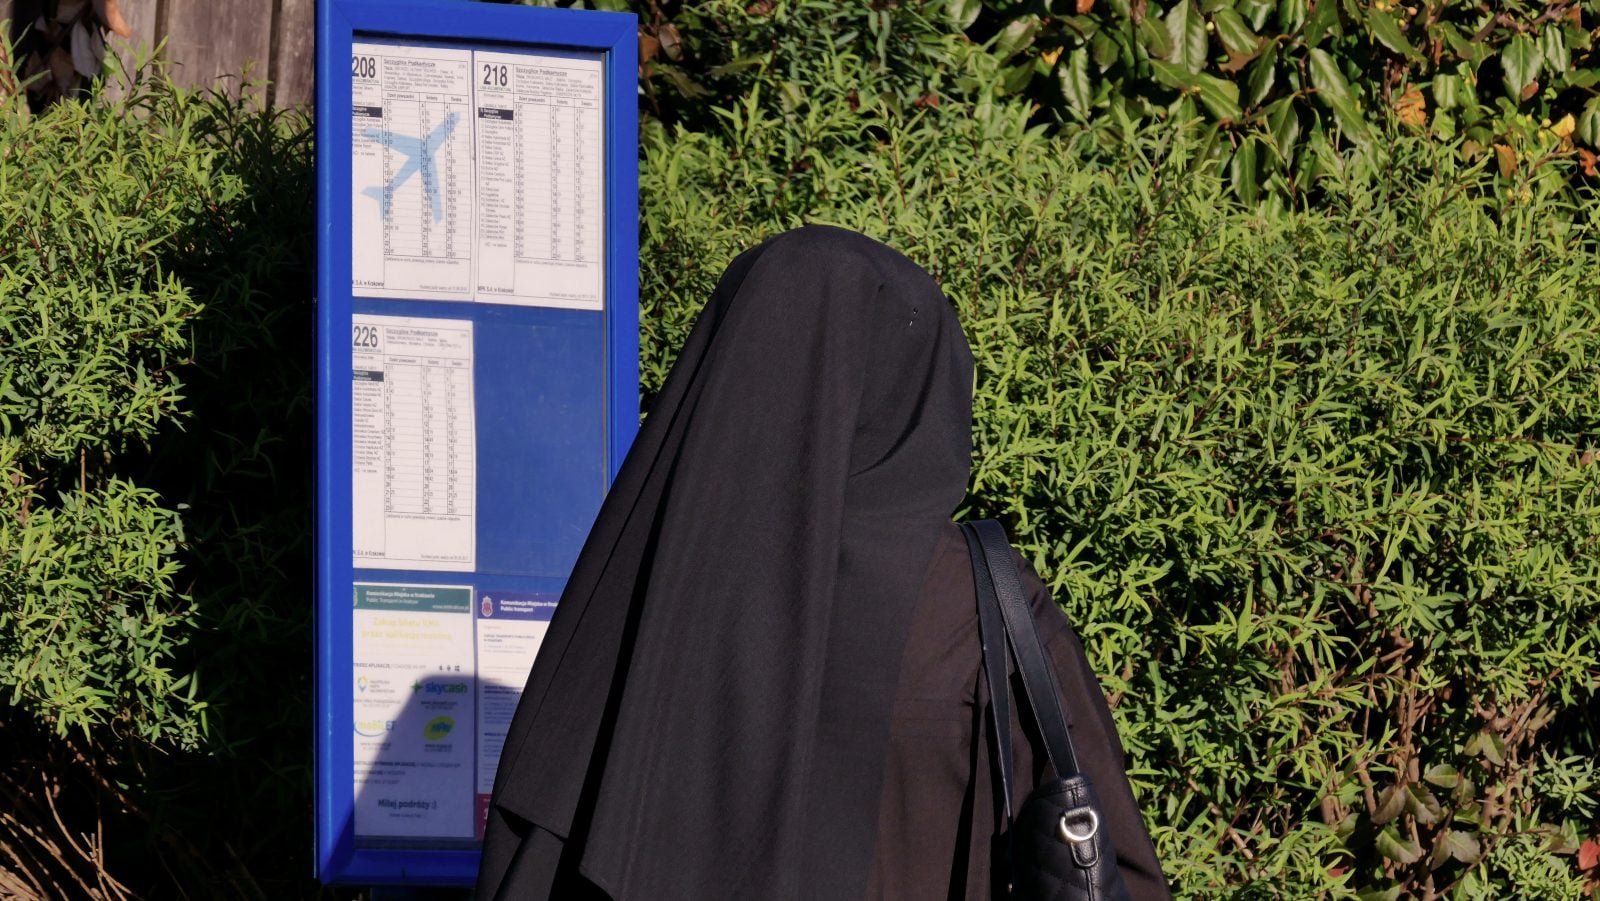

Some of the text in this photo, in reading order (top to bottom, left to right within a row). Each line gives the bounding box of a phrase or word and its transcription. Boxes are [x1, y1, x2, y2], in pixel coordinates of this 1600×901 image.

[352, 56, 376, 78] 208
[483, 64, 508, 86] 218
[354, 326, 378, 348] 226
[426, 682, 468, 695] skycash
